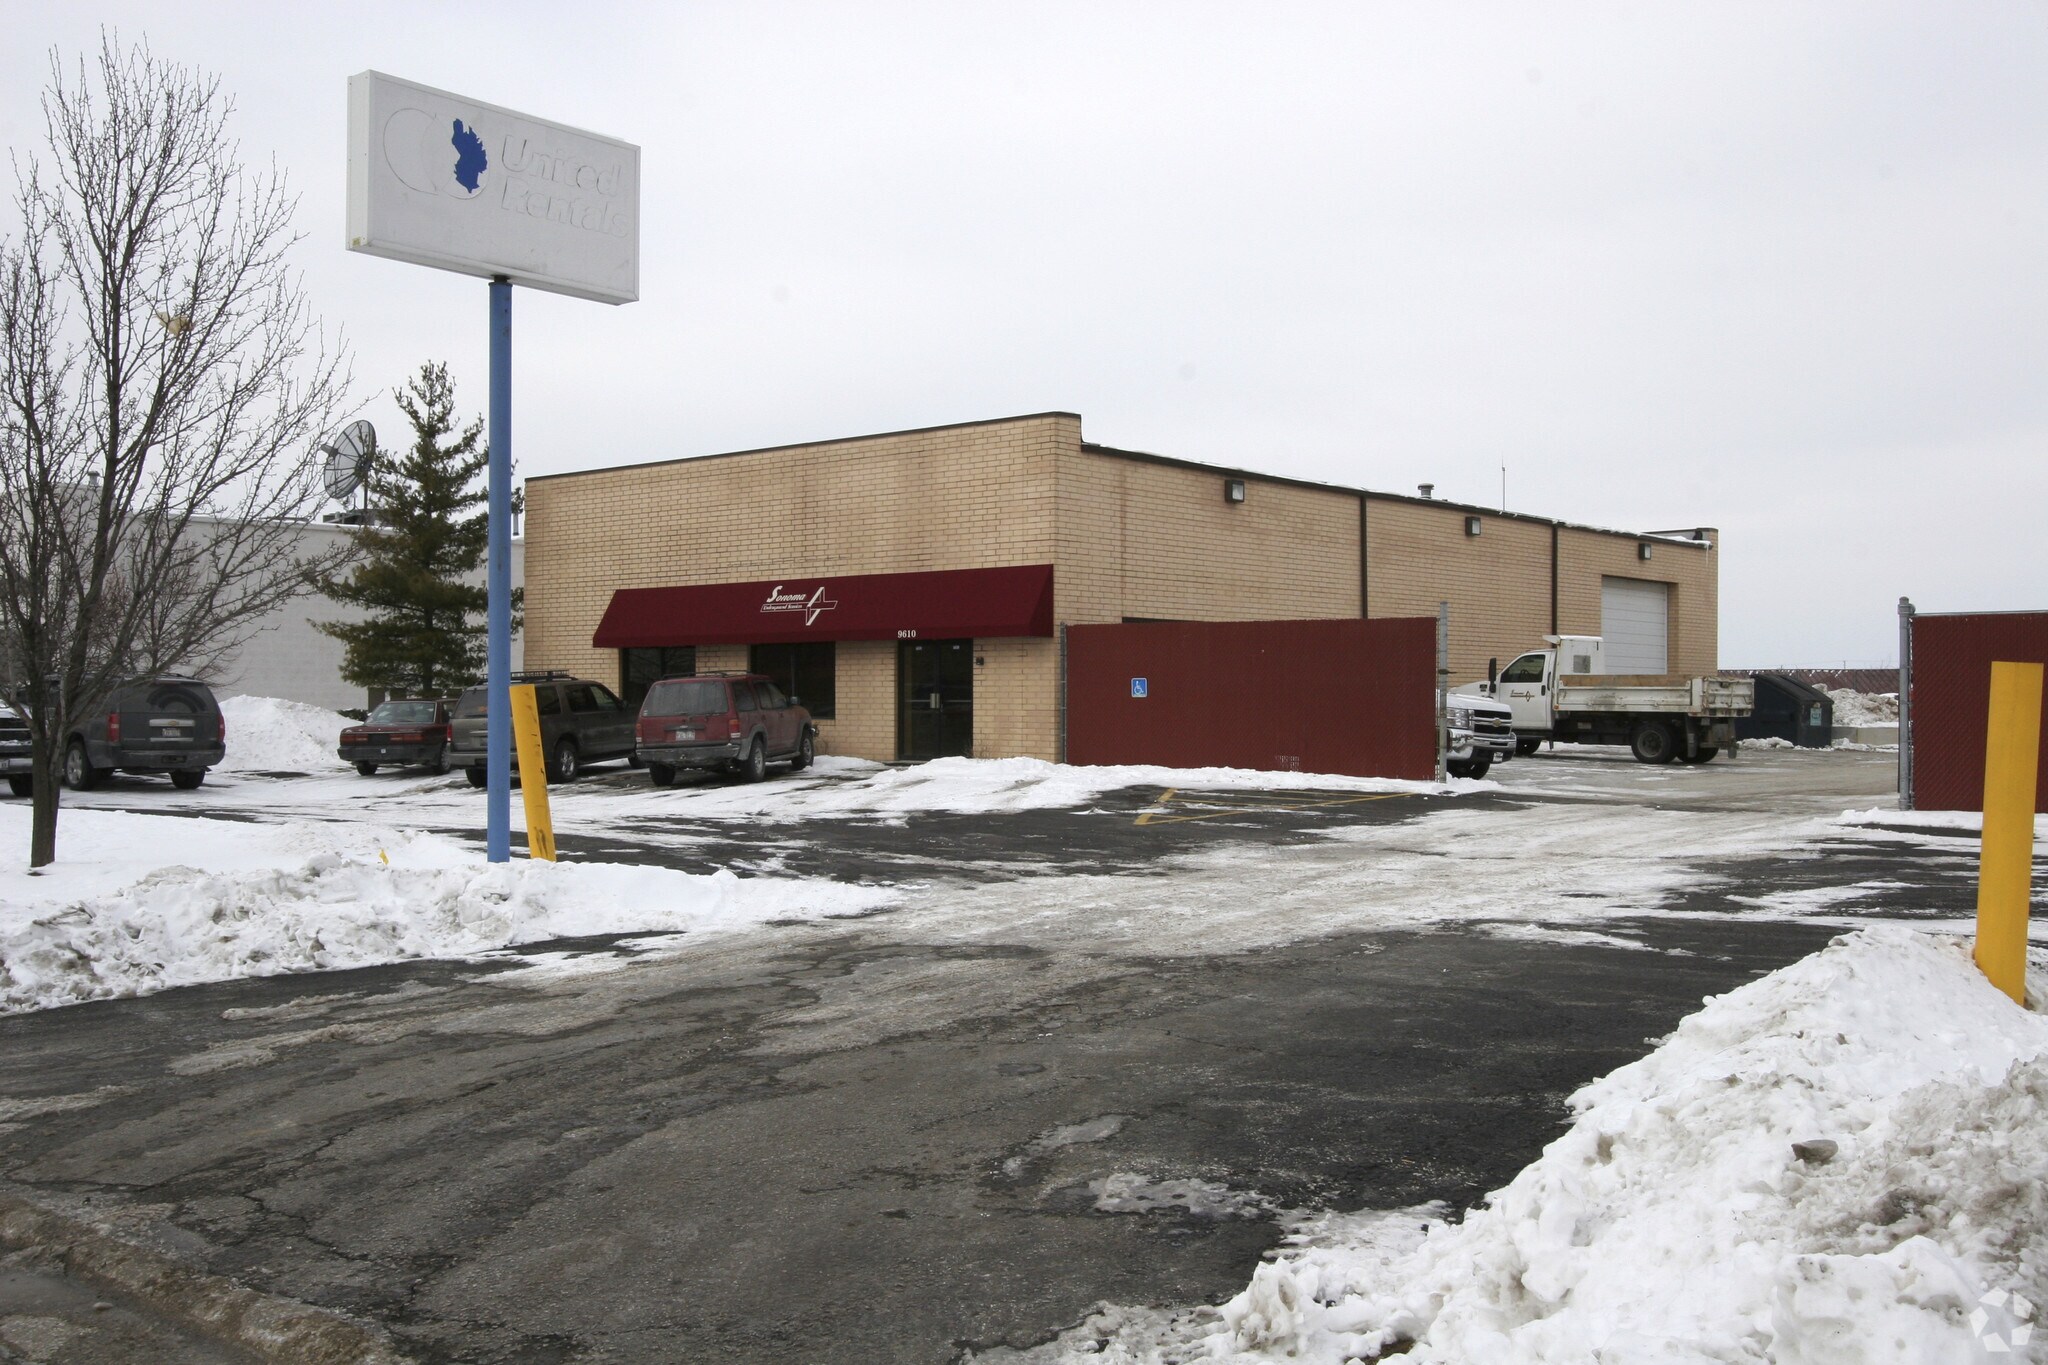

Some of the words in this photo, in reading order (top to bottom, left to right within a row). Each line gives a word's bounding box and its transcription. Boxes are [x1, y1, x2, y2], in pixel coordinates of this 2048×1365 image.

[501, 134, 622, 198] United
[501, 176, 629, 239] Rentals
[766, 585, 806, 603] Sonoma
[897, 629, 917, 639] 9610
